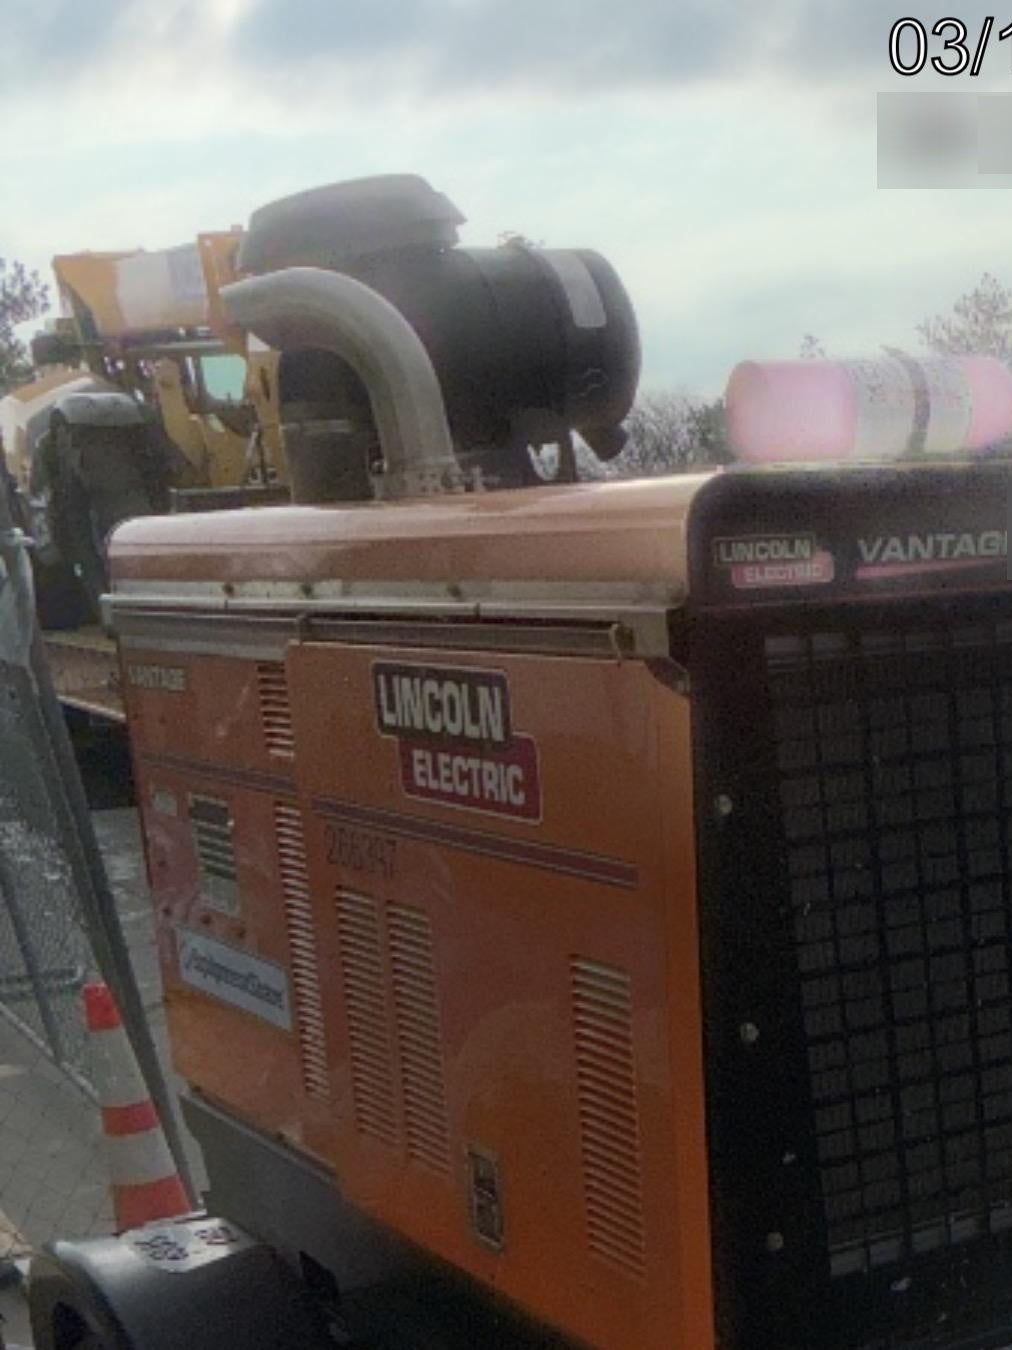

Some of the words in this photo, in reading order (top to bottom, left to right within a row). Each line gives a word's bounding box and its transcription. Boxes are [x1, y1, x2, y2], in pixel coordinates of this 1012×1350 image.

[718, 539, 811, 563] LINCOLN
[744, 562, 822, 583] ELECTRIC
[378, 674, 504, 741] LINCOLN
[412, 749, 525, 805] ELECTRIC
